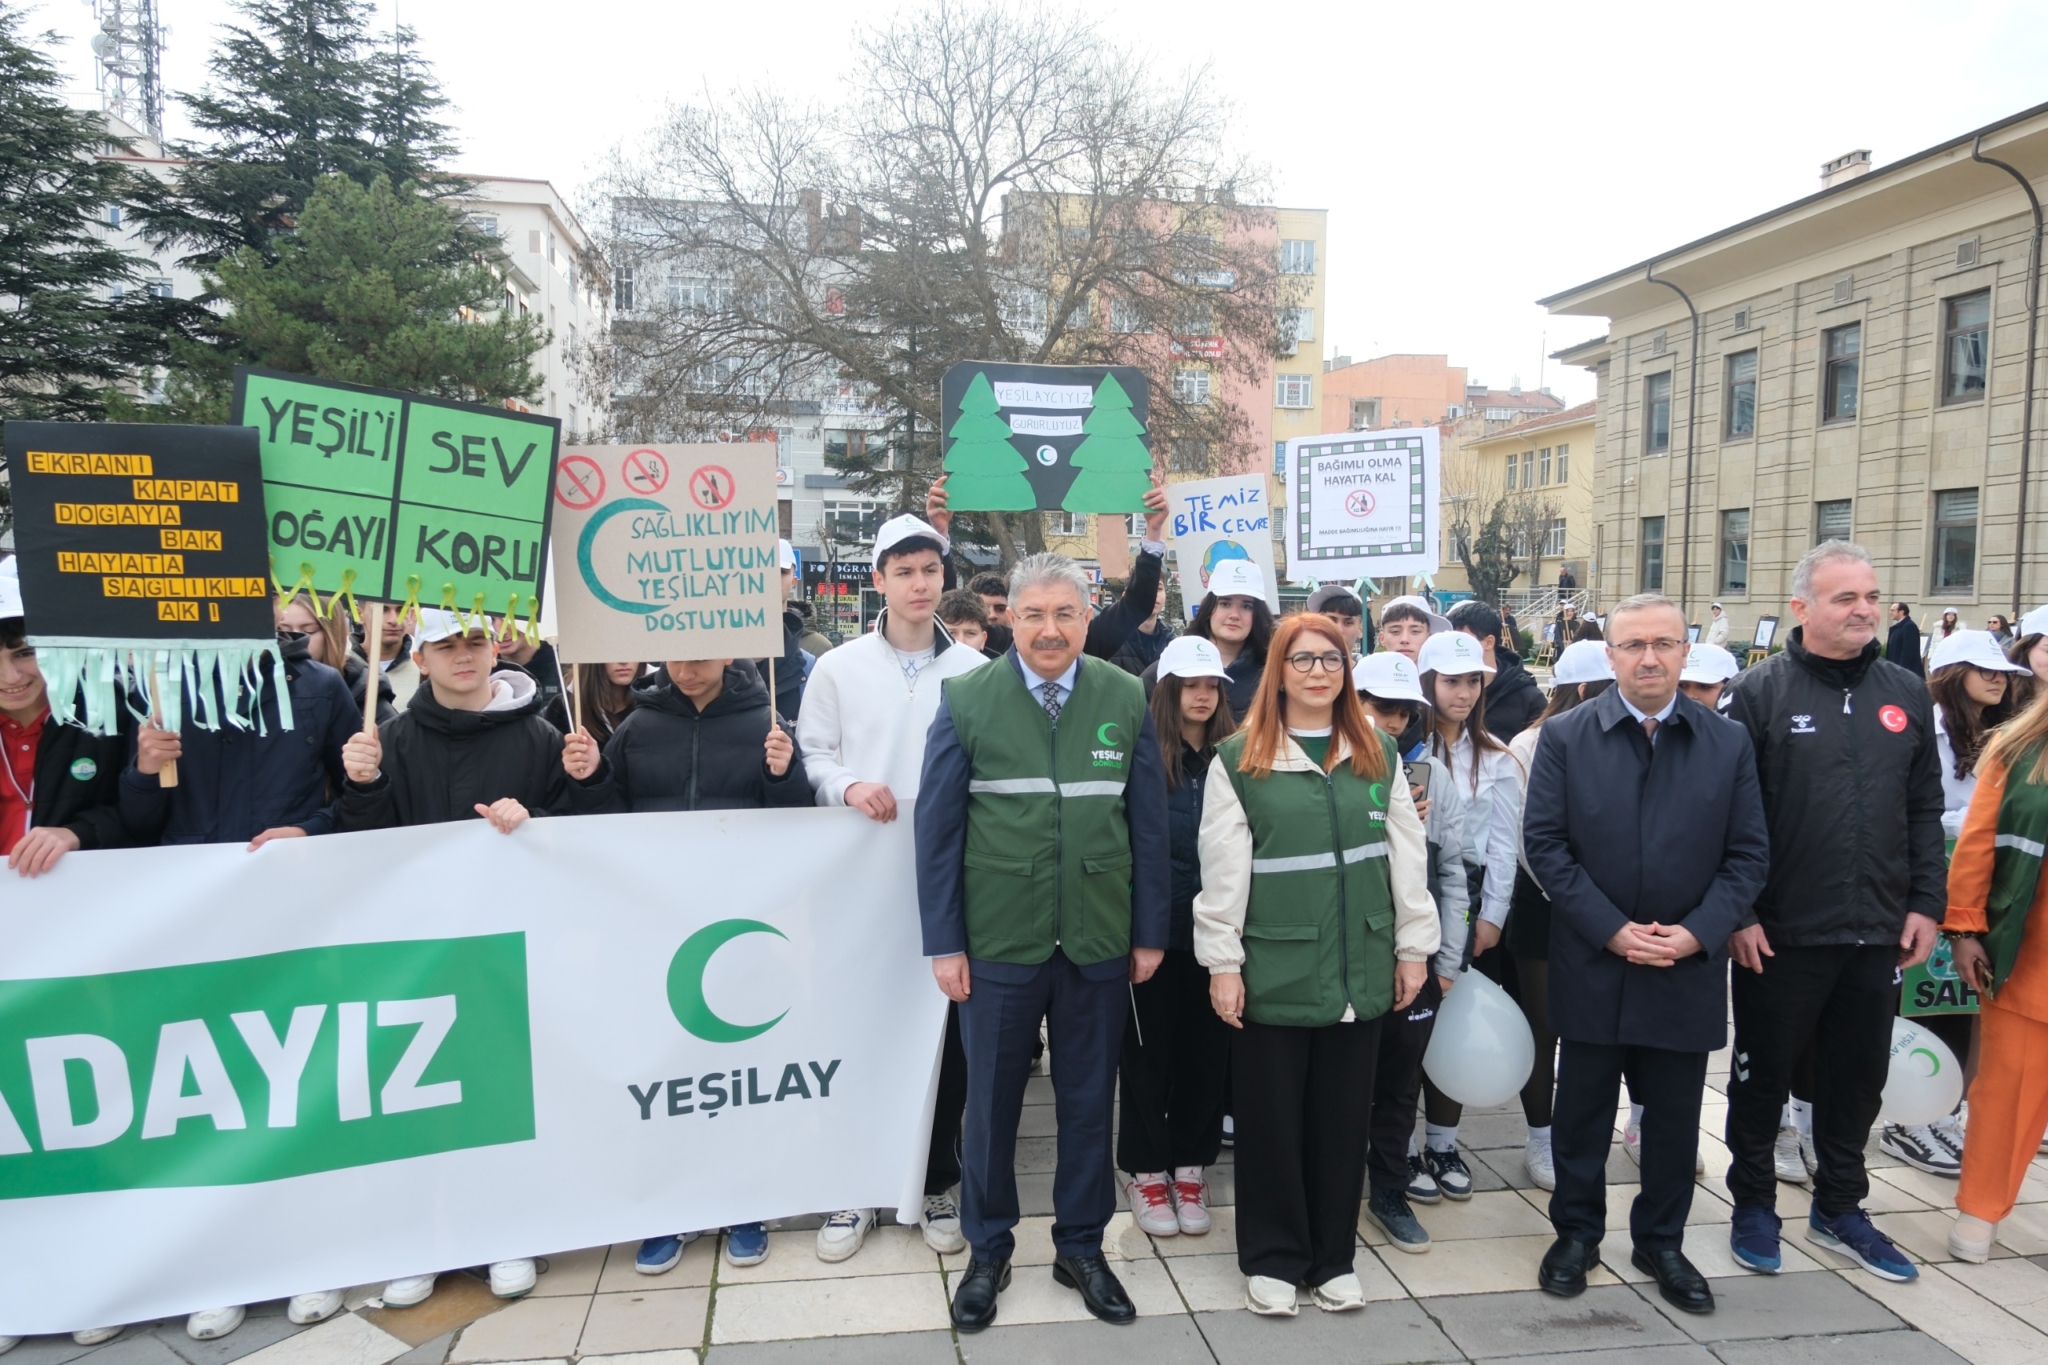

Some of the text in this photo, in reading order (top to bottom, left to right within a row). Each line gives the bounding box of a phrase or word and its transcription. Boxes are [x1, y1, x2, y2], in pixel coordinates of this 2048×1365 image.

[996, 387, 1090, 404] YEŞİLAYCIYIZ
[31, 453, 145, 474] EKRANI
[428, 430, 538, 488] SEV
[1317, 457, 1402, 472] BAĞIMLI OLMA
[1324, 472, 1396, 486] HAYATTA KAL
[137, 481, 234, 500] KAPAT
[58, 504, 178, 524] DOĞAYA
[631, 506, 776, 539] SAĞLIKLIYIM
[164, 531, 219, 549] BAK
[272, 509, 387, 561] OĞAYI
[62, 553, 182, 573] HAYATA
[415, 524, 539, 583] KORU
[627, 546, 775, 574] MUTLUYUM
[107, 578, 264, 597] SAĞLIKLA
[161, 602, 196, 620] AK
[645, 607, 765, 631] DOSTUYUM
[627, 1059, 842, 1120] YEŞİLAY
